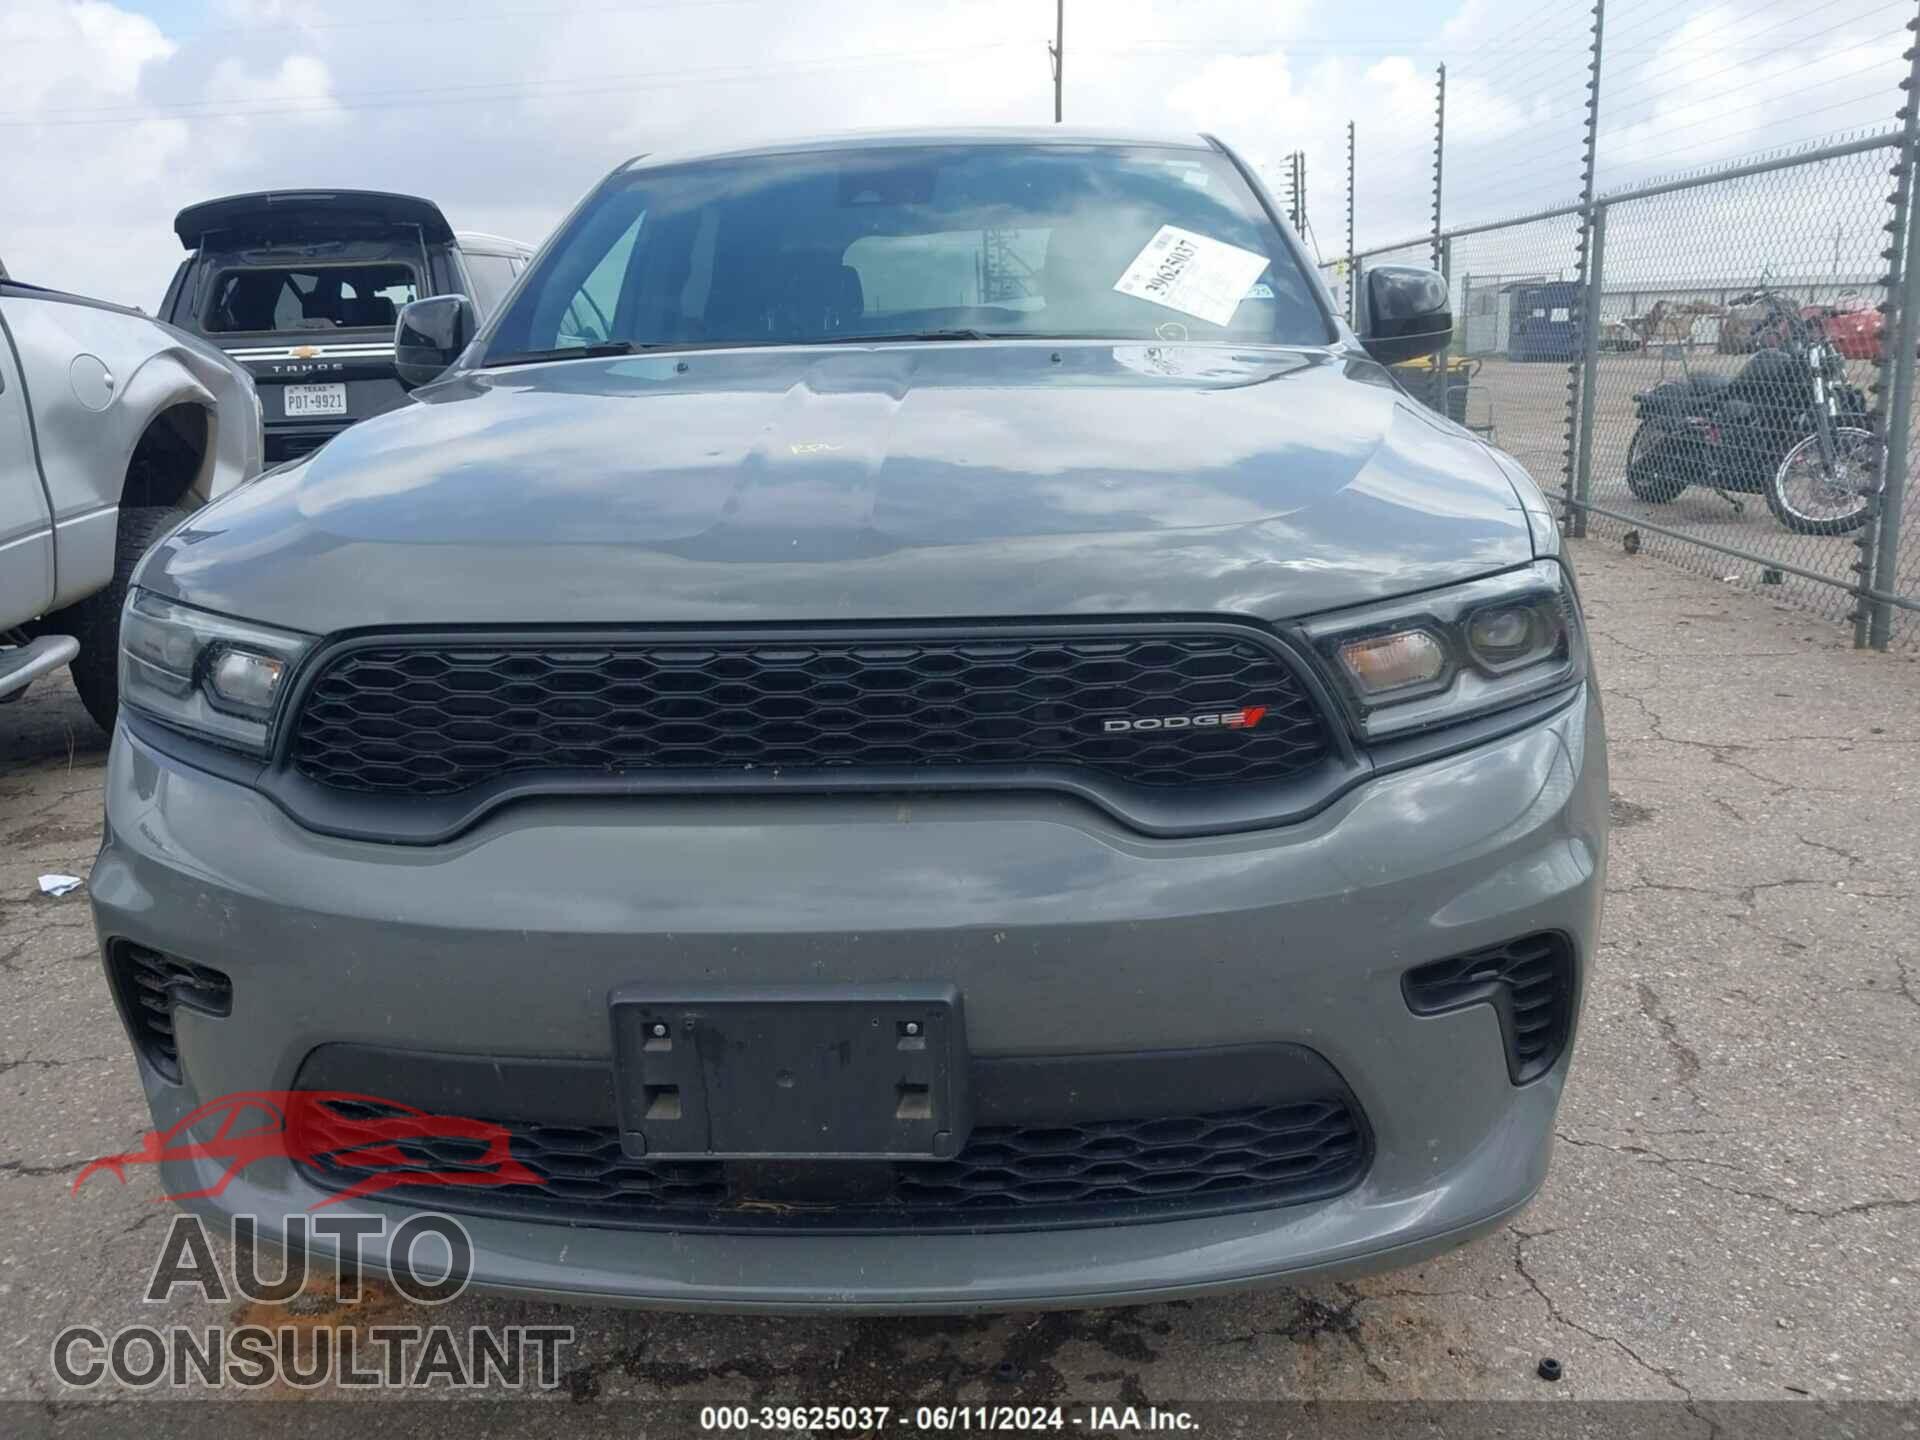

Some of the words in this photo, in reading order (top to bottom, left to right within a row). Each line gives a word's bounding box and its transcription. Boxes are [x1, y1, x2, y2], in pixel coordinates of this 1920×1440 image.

[1145, 239, 1199, 296] 39625037
[272, 363, 343, 372] TAHOE
[1104, 712, 1246, 732] DODGE
